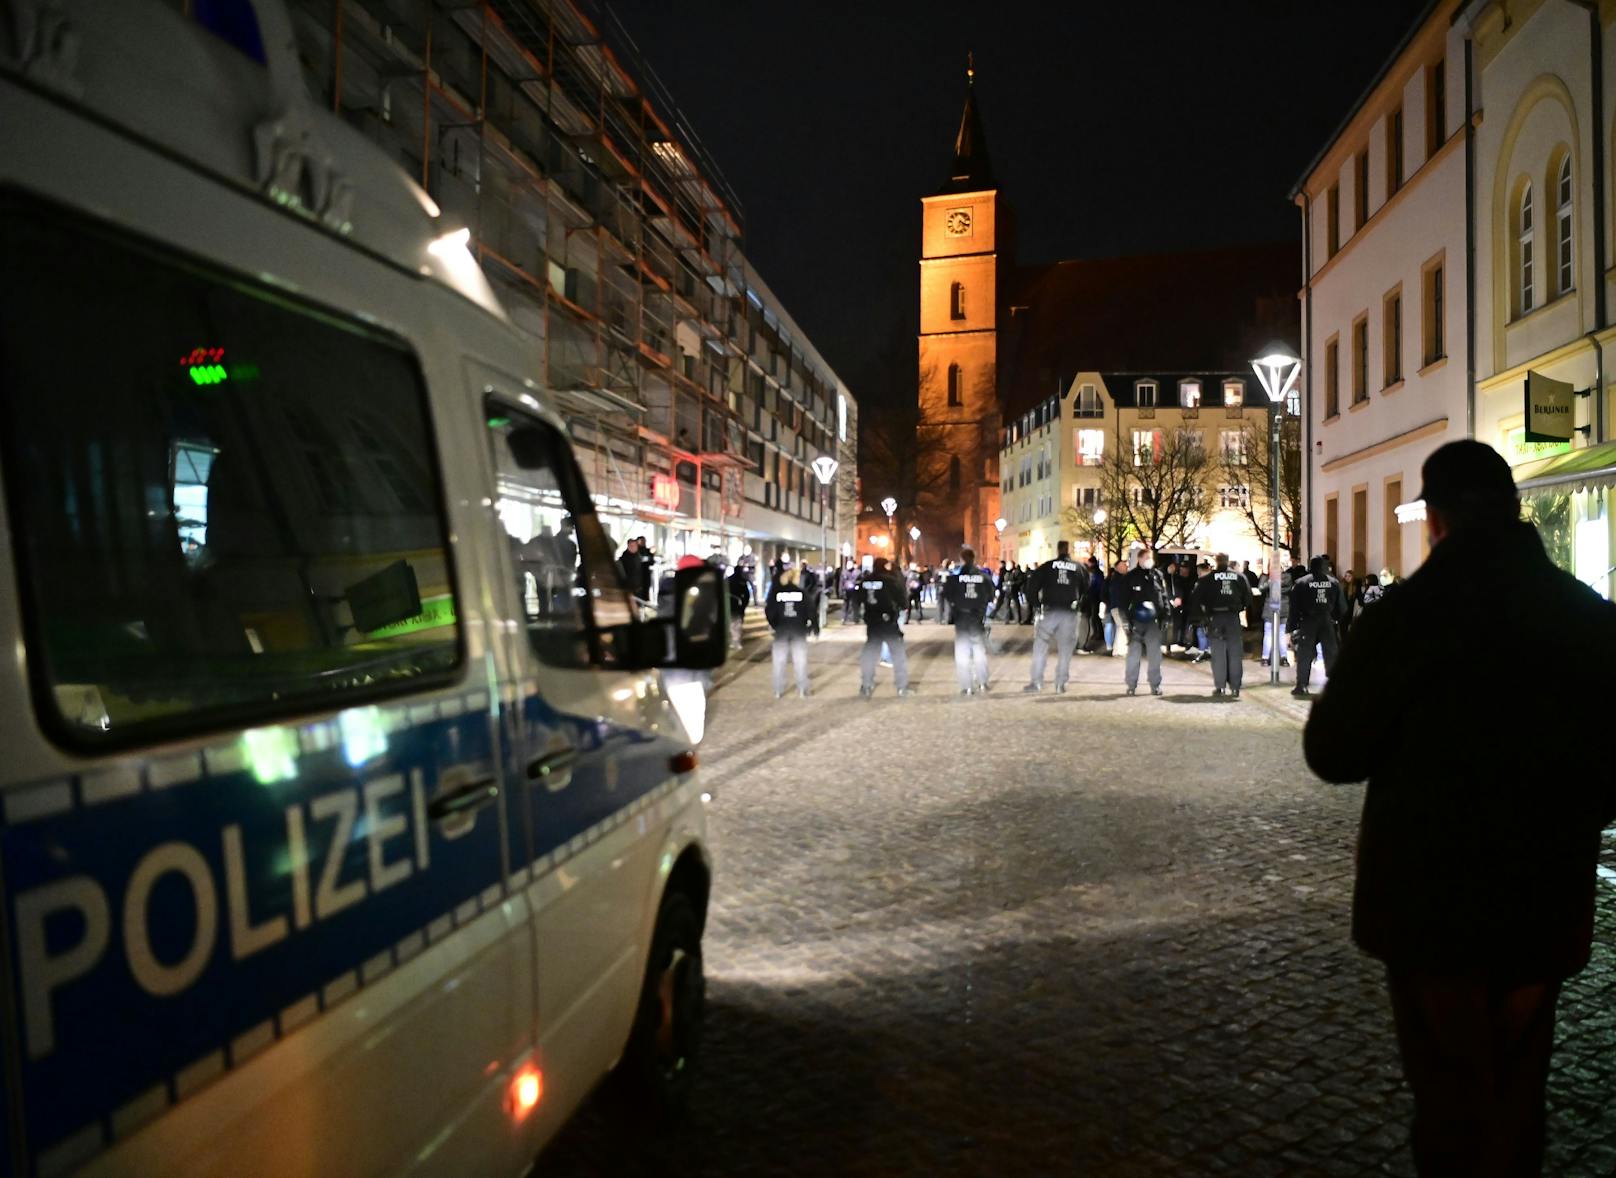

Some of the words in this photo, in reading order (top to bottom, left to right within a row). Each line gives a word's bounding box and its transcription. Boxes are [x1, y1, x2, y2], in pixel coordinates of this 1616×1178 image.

[1534, 404, 1569, 415] BERLINER
[1214, 572, 1237, 580] POLIZEI
[15, 767, 431, 1062] POLIZEI
